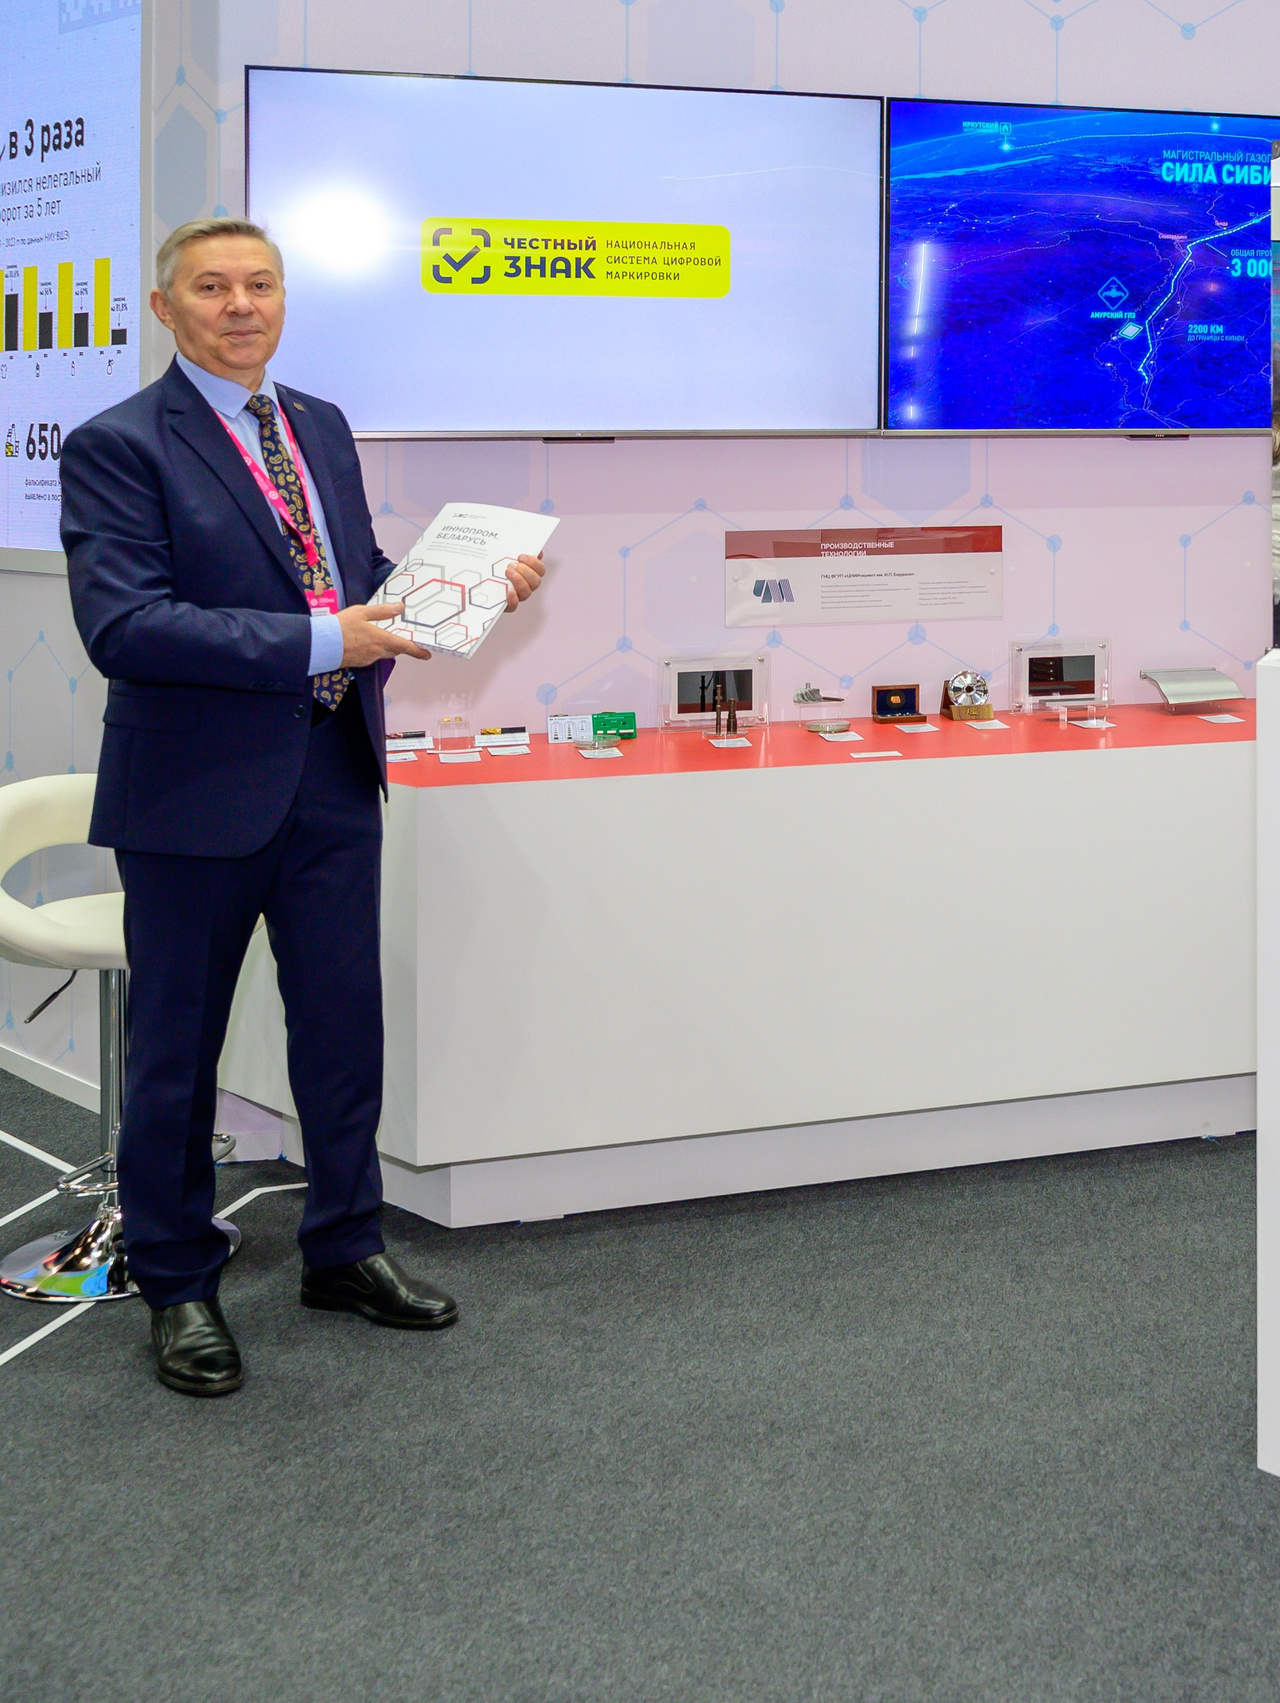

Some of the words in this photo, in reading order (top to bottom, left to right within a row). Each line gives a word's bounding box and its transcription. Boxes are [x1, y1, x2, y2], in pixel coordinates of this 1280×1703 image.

[962, 121, 999, 129] ИРКУТСКИЙ
[24, 118, 35, 157] 3
[40, 117, 85, 163] раза
[1162, 149, 1243, 162] МАГИСТРАЛЬНЫЙ
[35, 160, 102, 192] нелегальный
[1161, 161, 1218, 183] СИЛА
[23, 203, 35, 220] за
[36, 197, 43, 218] 5
[44, 199, 62, 217] лет
[503, 236, 597, 251] ЧЕСТНЫЙ
[606, 239, 697, 251] НАЦИОНАЛЬНАЯ
[1230, 249, 1255, 257] ОБЩАЯ
[503, 255, 597, 280] ЗНАК
[606, 255, 659, 267] СИСТЕМА
[663, 255, 722, 268] ЦИФРОВОЙ
[1230, 259, 1242, 278] 3
[1246, 259, 1272, 278] 00
[606, 271, 681, 281] МАРКИРОВКИ
[1090, 311, 1123, 319] АМУРСКИЙ
[1188, 325, 1209, 334] 2200
[1210, 325, 1224, 334] КМ
[26, 422, 61, 461] 650
[436, 532, 486, 545] БЕЛАРУСЬ
[820, 541, 895, 550] ПРОИЗВОДСТВЕННЫЕ
[820, 549, 867, 557] ТЕХНОЛОГИИ
